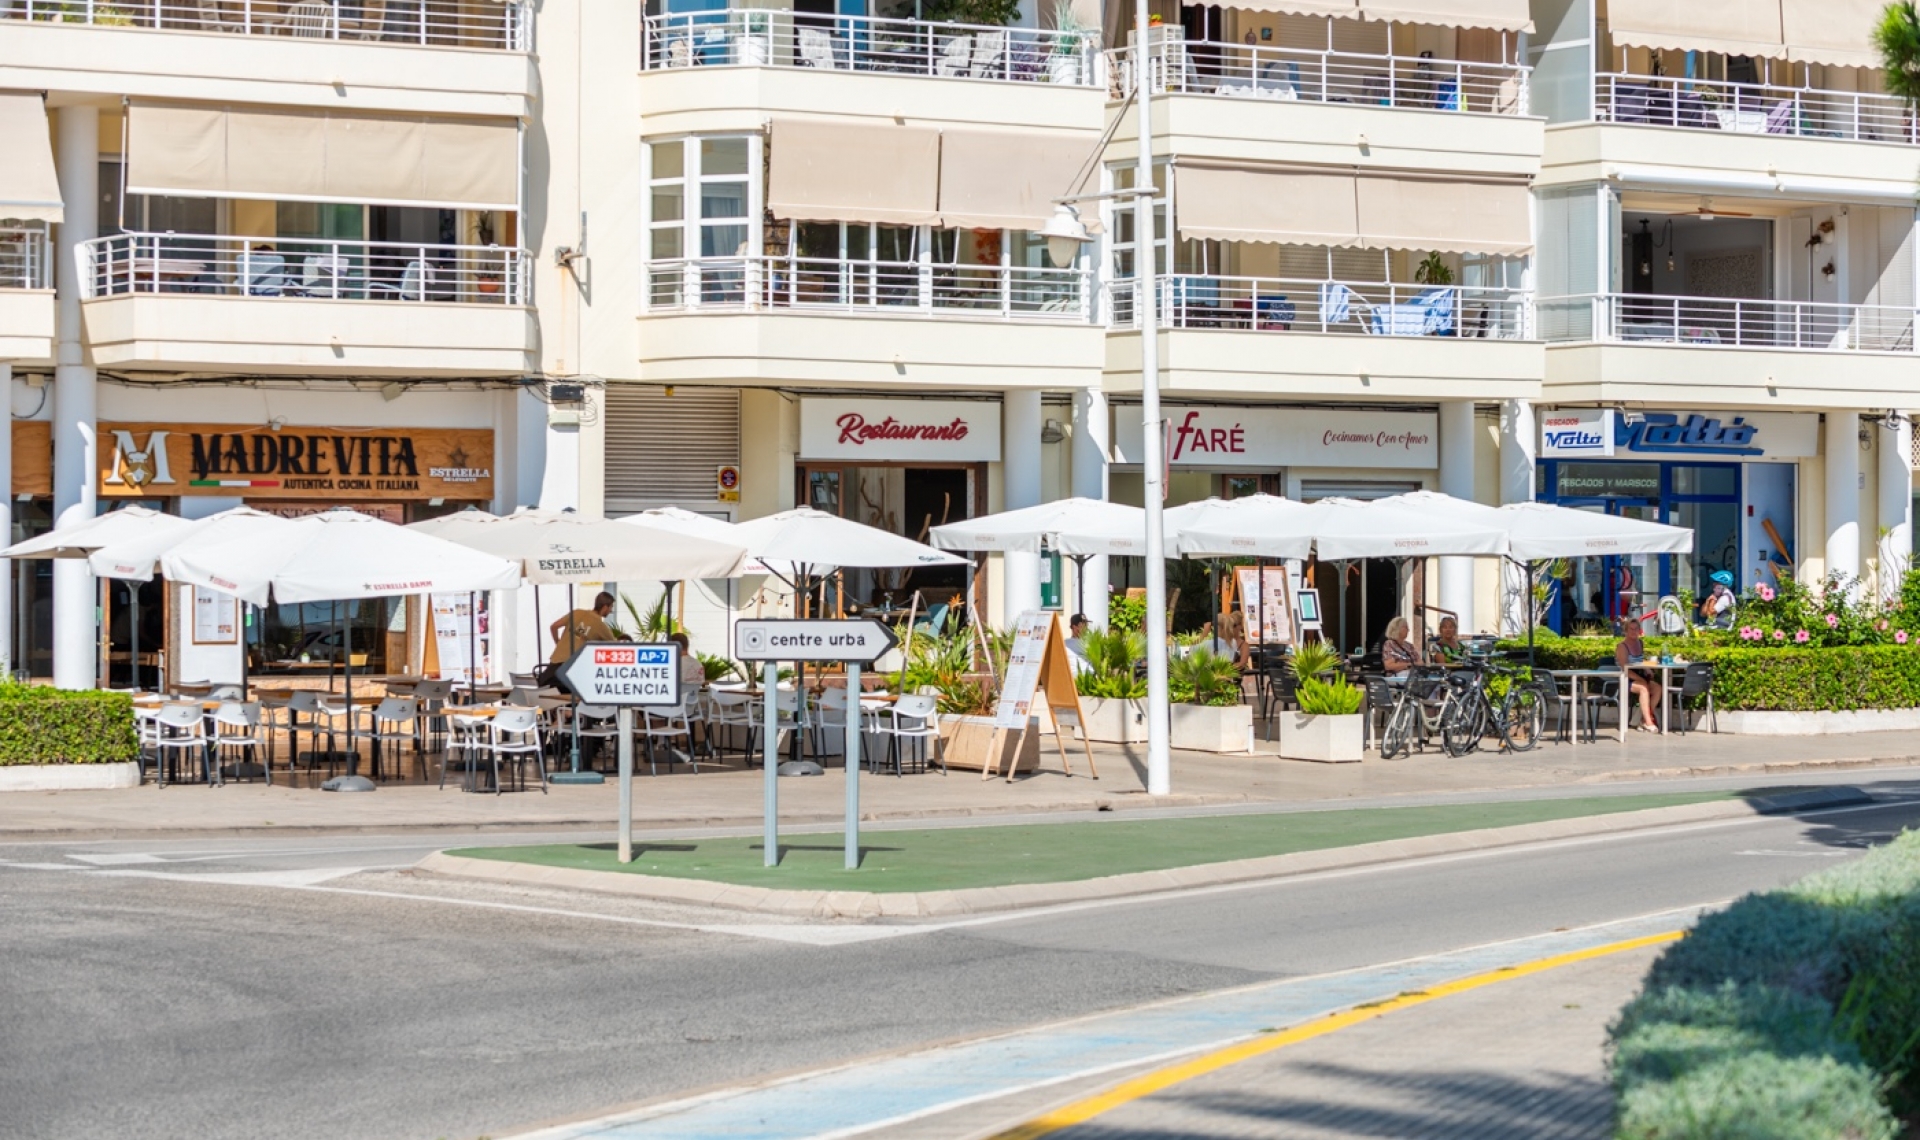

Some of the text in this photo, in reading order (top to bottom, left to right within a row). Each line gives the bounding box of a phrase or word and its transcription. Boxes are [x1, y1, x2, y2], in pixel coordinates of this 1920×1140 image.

[836, 413, 968, 444] Restaurante
[1545, 418, 1579, 427] PESCADOS
[1323, 429, 1429, 450] Cocinamos Con Amor
[190, 433, 420, 480] MADREVITA
[429, 468, 490, 478] ESTRELLA
[283, 478, 420, 491] AUTENTICA CUCINA ITALIANA
[1559, 478, 1658, 488] PESCADOS Y MARISCOS
[539, 558, 605, 570] ESTRELLA
[373, 581, 433, 591] ESTRELLA DAMM
[770, 633, 823, 646] centre
[597, 651, 668, 660] N-332 AP-7
[595, 667, 669, 679] ALICANTE
[595, 683, 669, 695] VALENCIA
